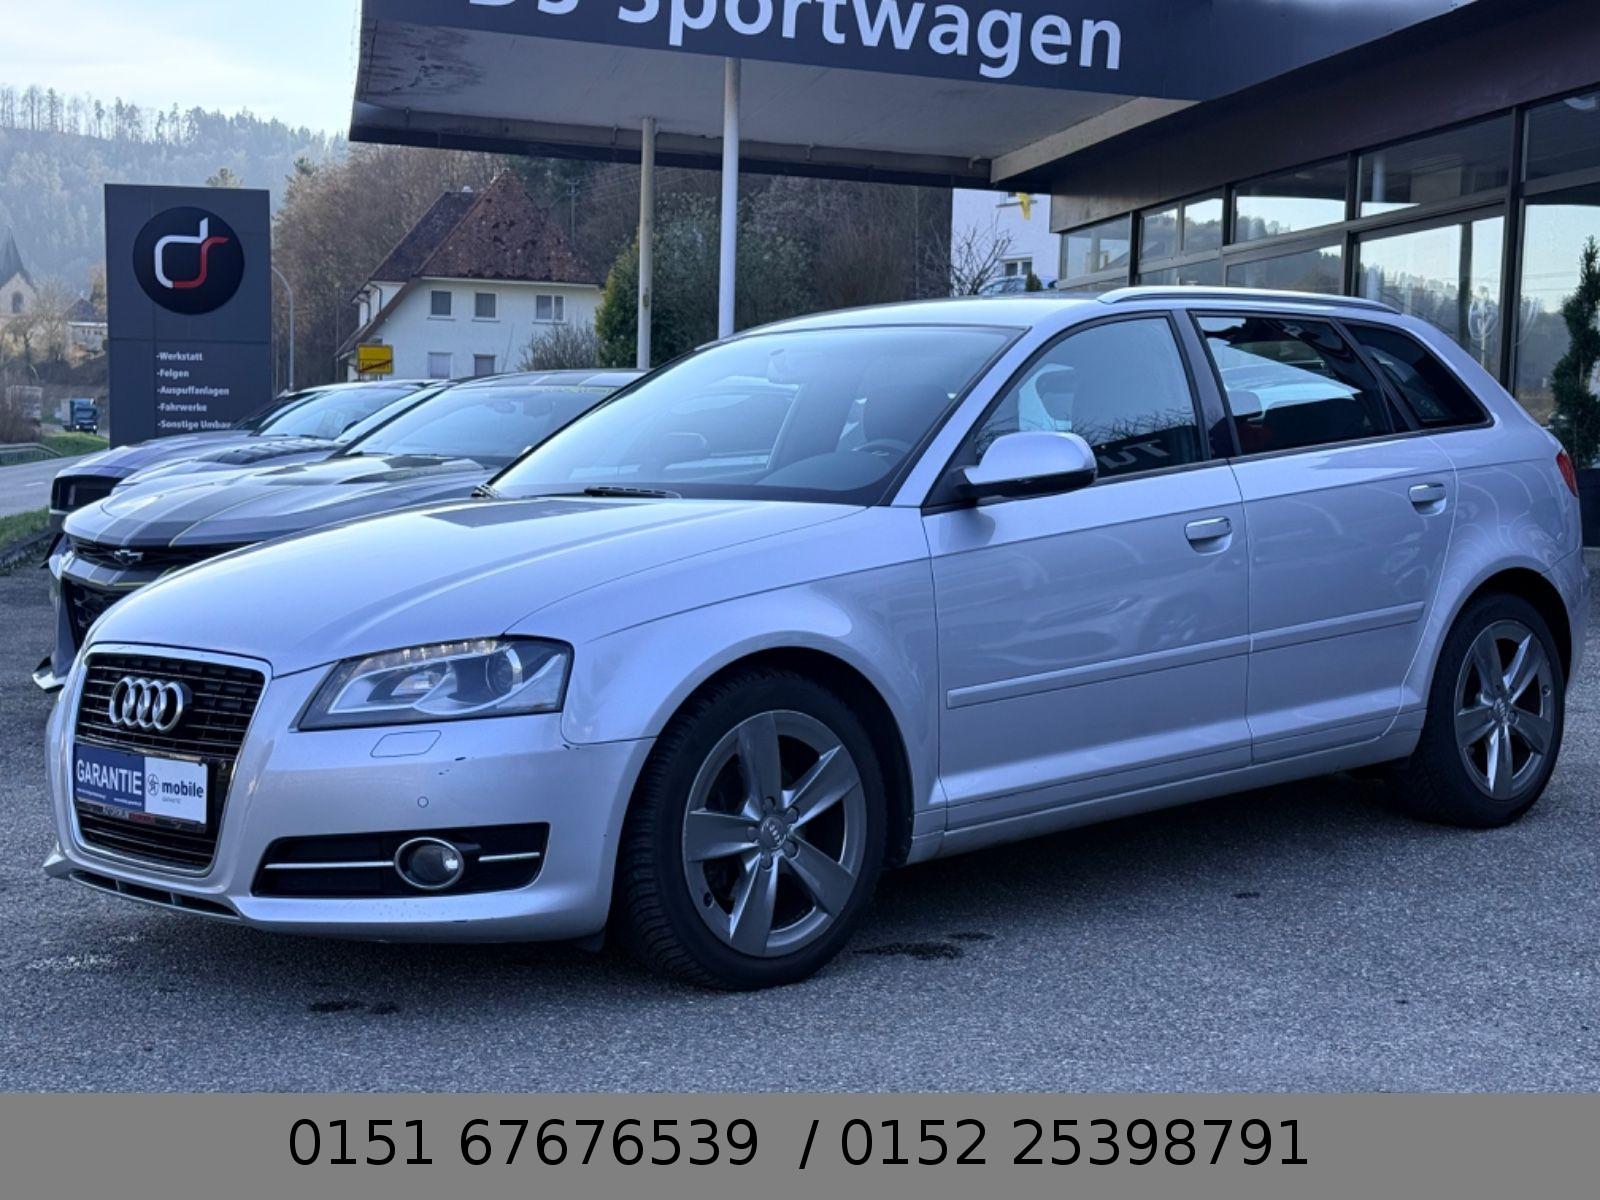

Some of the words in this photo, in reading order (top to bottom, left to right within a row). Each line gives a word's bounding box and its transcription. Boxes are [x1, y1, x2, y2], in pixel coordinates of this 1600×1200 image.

[156, 351, 203, 361] -Werkstatt
[156, 368, 190, 380] -Felgen
[156, 385, 230, 397] -Auspuffanlagen
[157, 402, 207, 412] -Fahrwerke
[76, 759, 142, 796] GARANTIE
[161, 780, 204, 798] mobile
